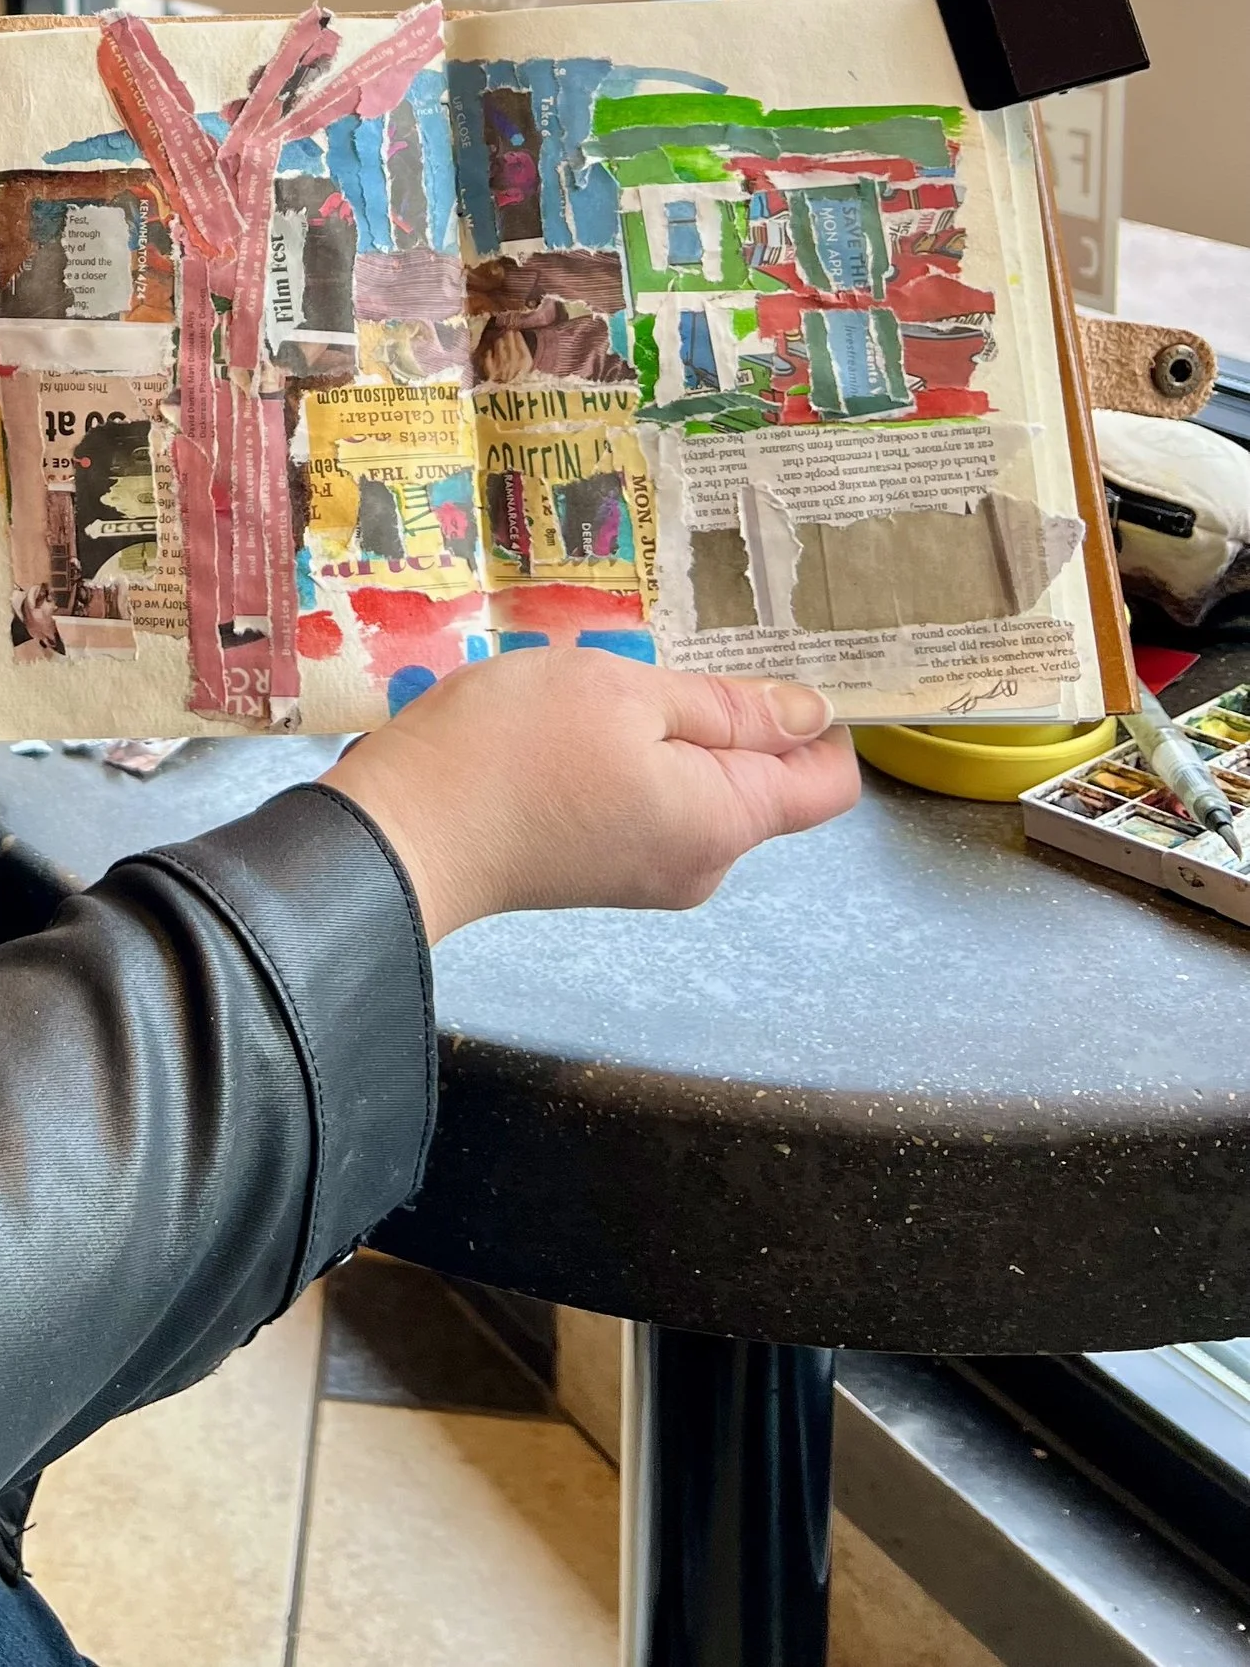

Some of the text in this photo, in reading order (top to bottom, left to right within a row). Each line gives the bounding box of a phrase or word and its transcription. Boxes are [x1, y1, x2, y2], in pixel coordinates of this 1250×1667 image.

[540, 96, 554, 127] Take
[456, 114, 471, 148] CLOSE
[69, 216, 89, 226] Fest,
[842, 206, 861, 248] SAVE
[68, 229, 100, 241] through
[77, 243, 86, 252] of
[136, 199, 149, 300] KEN WHEATON 4/24
[98, 257, 112, 266] the
[827, 249, 842, 276] APR
[74, 271, 107, 280] a closer
[268, 233, 293, 323] Film Fest
[54, 382, 108, 394] This month
[340, 409, 435, 426] Calendar:
[45, 410, 76, 442] at
[756, 432, 768, 441] to
[759, 426, 991, 455] Isthmus ran a cooking column from Suzanne
[770, 429, 792, 440] 1981
[913, 439, 962, 454] anymore.
[963, 442, 974, 451] at
[976, 440, 993, 449] eat
[805, 452, 872, 465] remembered
[882, 448, 909, 458] Then
[782, 457, 804, 467] that
[244, 425, 256, 514] Shakespeare's
[367, 466, 409, 481] FRI.
[699, 463, 748, 475] make the
[776, 454, 995, 484] a bunch of closed restaurants people can't
[972, 467, 998, 480] sary.
[700, 477, 749, 490] tried the
[880, 477, 907, 489] avoid
[910, 476, 921, 486] to
[924, 472, 963, 484] wanted
[803, 481, 837, 495] poetic
[838, 479, 877, 492] waxing
[631, 474, 653, 529] MON.
[697, 490, 730, 503] trying
[821, 485, 988, 510] Madison circa 1976 for our 35th
[504, 474, 520, 540] RAMNARACE
[695, 507, 731, 518] was an
[544, 527, 556, 547] 8pm
[144, 600, 159, 609] we
[133, 617, 175, 628] Madison
[735, 631, 754, 642] and
[757, 629, 791, 641] Marge
[911, 627, 944, 641] round
[947, 625, 991, 637] cookies.
[1000, 619, 1061, 633] discovered
[693, 632, 897, 661] that often answered reader requests for
[914, 642, 956, 656] streusel
[959, 640, 977, 651] did
[980, 637, 1018, 649] resolve
[1021, 634, 1044, 644] into
[708, 662, 723, 673] for
[725, 662, 752, 673] some
[754, 659, 766, 669] of
[768, 657, 792, 668] their
[795, 653, 836, 666] favorite
[839, 649, 885, 662] Madison
[931, 651, 1044, 668] the trick is somehow
[918, 665, 1039, 685] onto the cookie sheet.
